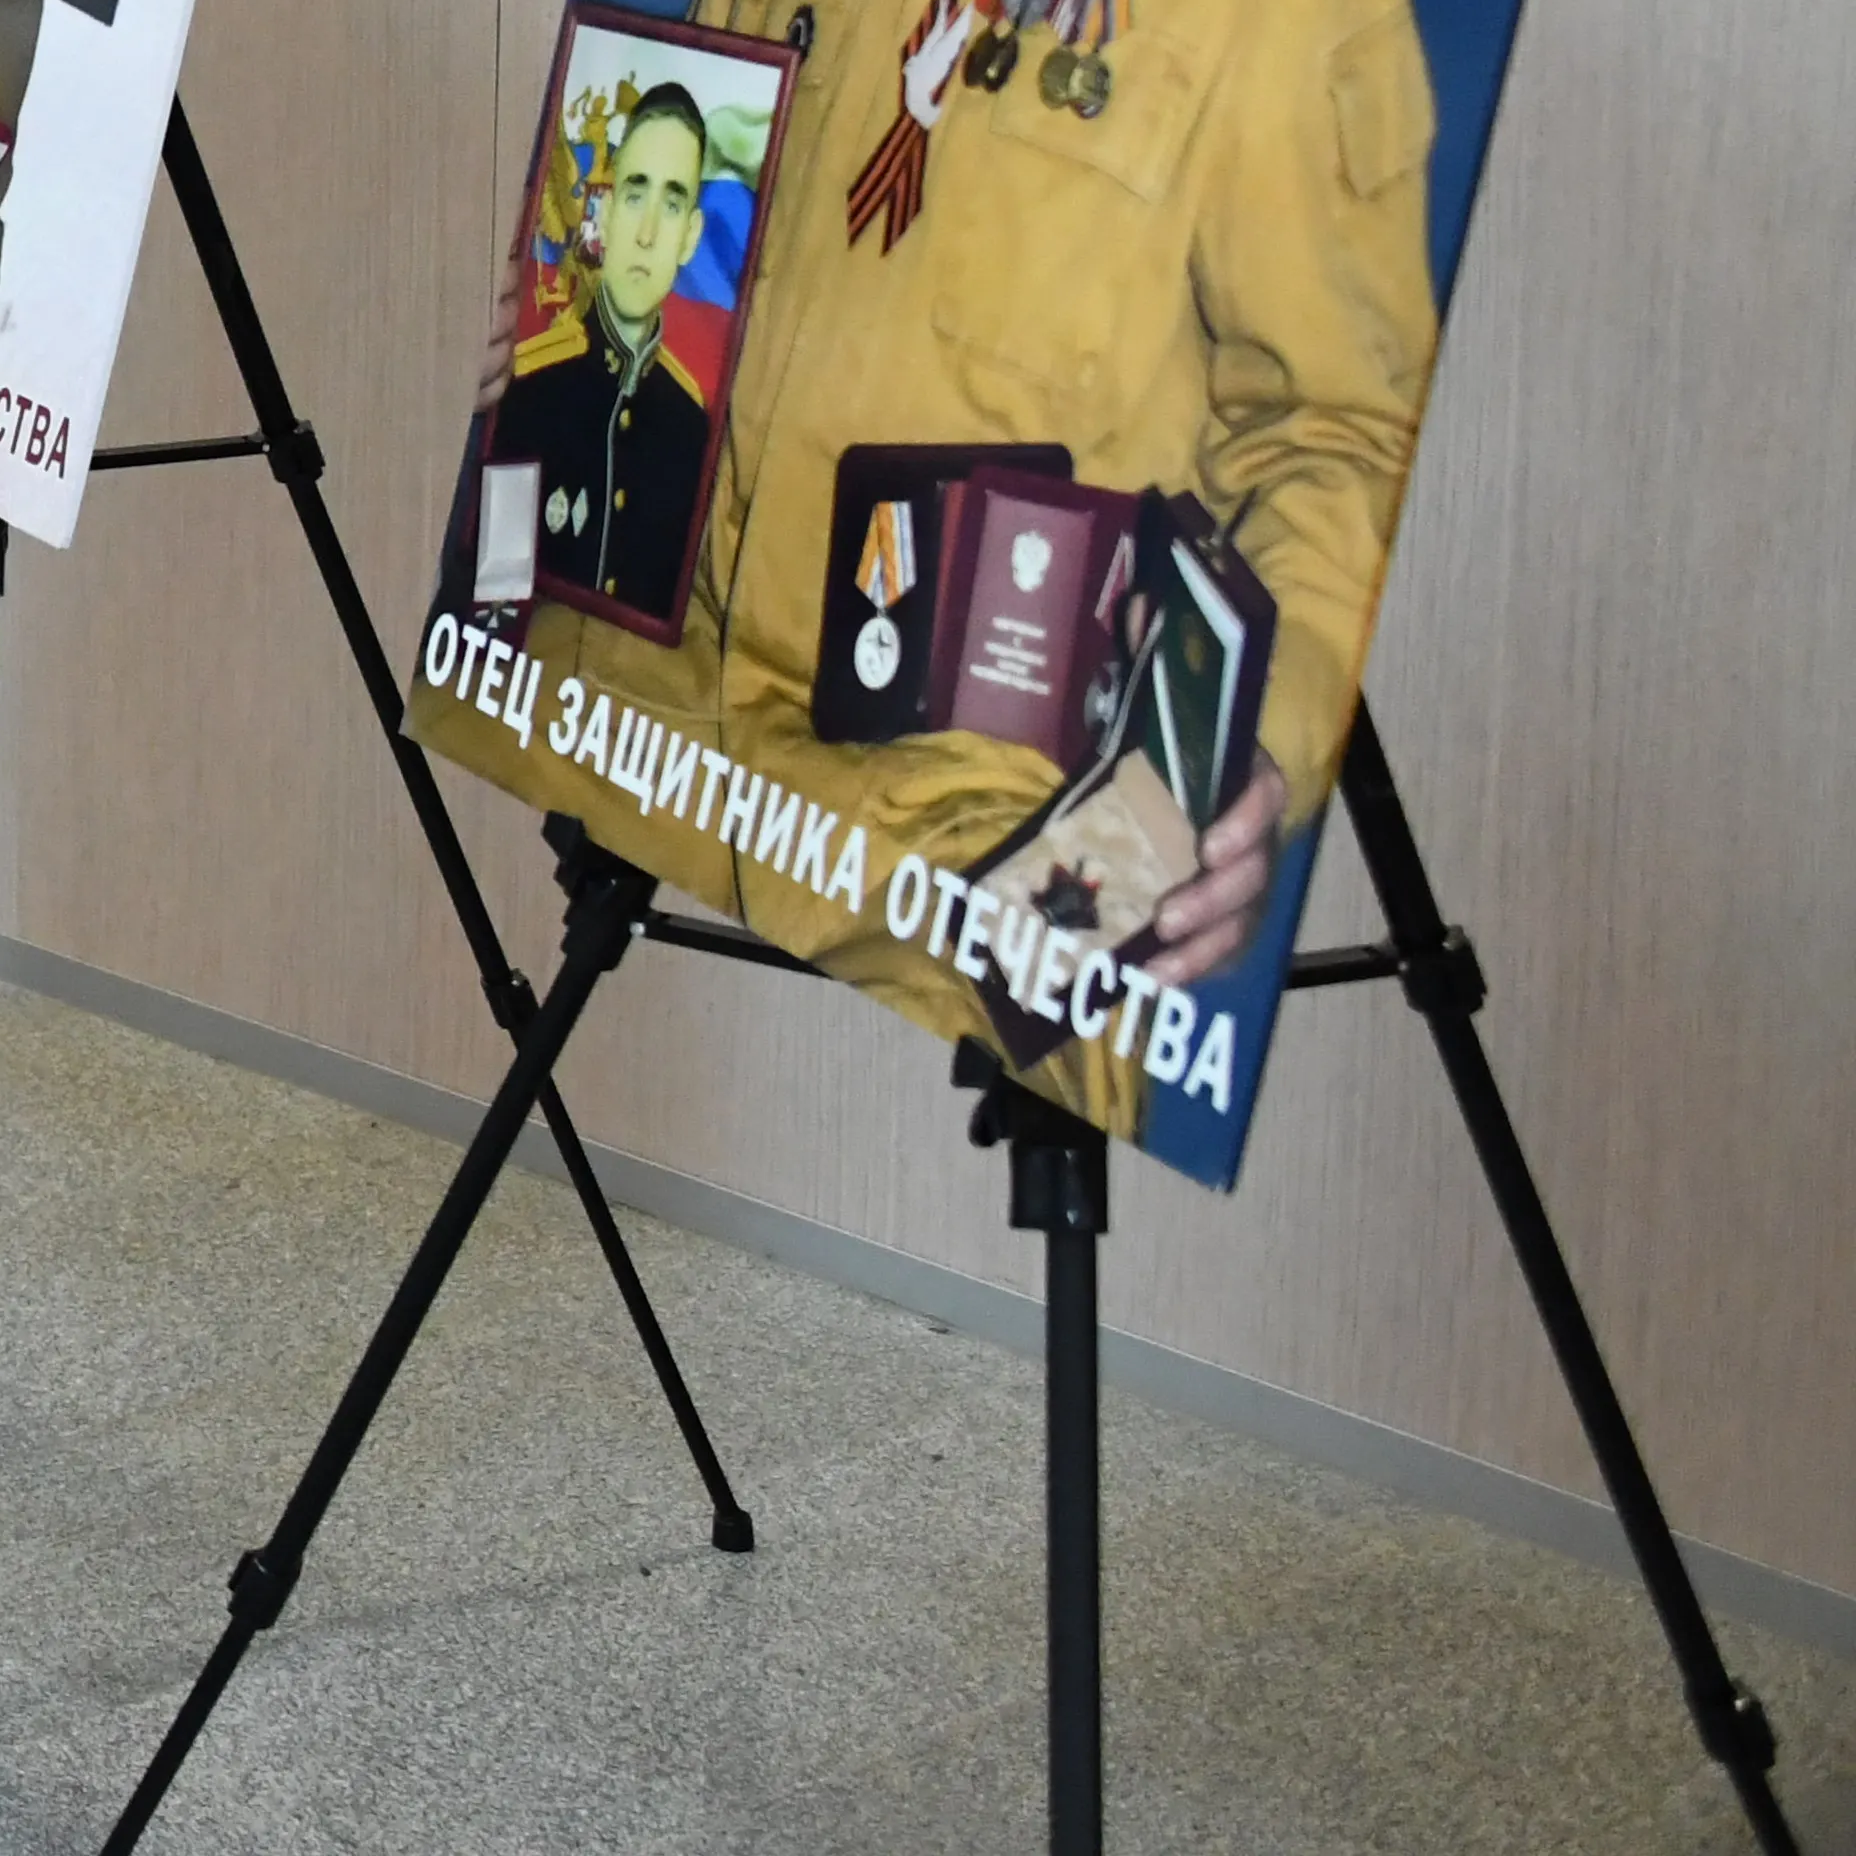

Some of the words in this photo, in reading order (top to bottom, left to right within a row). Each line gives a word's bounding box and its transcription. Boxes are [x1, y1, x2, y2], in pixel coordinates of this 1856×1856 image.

[424, 612, 544, 750] ОТЕЦ
[548, 677, 868, 915] ЗАЩИТНИКА
[886, 853, 1237, 1116] ОТЕЧЕСТВА
